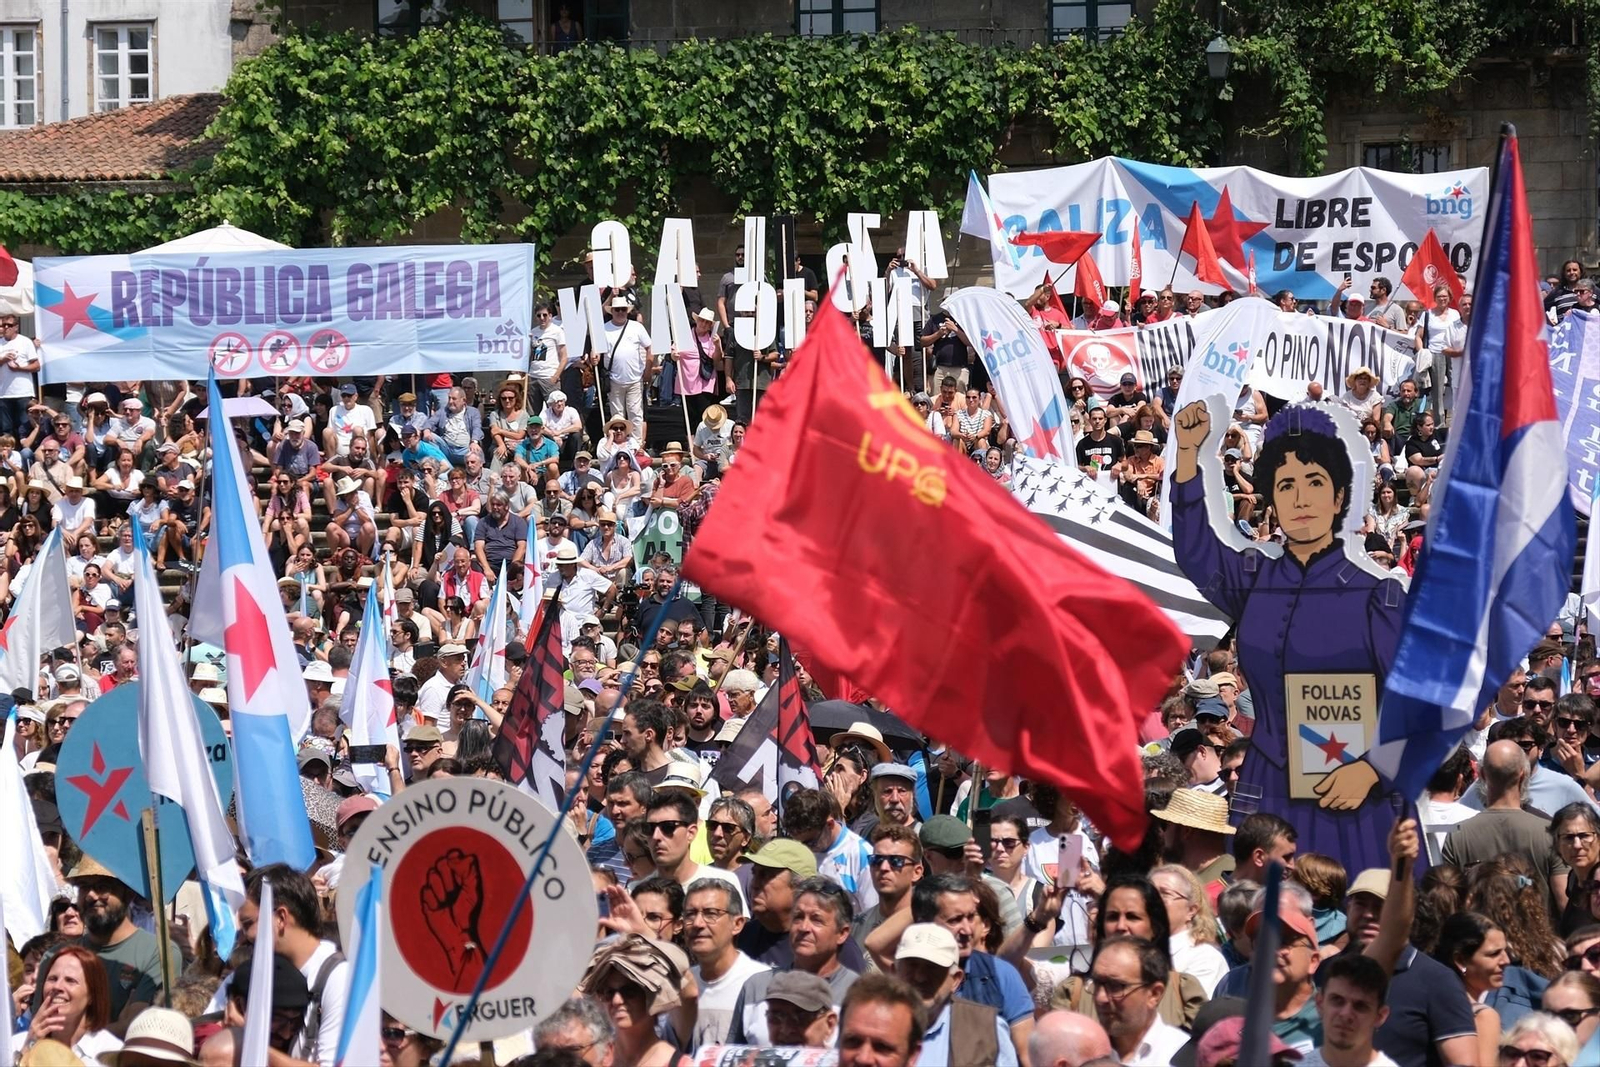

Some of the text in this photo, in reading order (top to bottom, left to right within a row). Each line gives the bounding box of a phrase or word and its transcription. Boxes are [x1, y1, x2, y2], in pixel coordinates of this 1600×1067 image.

[1275, 197, 1372, 229] LIBRE
[1425, 193, 1473, 220] bng
[1272, 241, 1472, 274] DE ESPOO
[111, 256, 502, 329] REPÚBLICA GALEGA
[476, 333, 524, 360] bng
[1281, 333, 1320, 382] PINO
[1324, 322, 1387, 397] NON
[1302, 685, 1362, 701] FOLLAS
[1306, 705, 1362, 721] NOVAS
[367, 788, 565, 900] ENSINO PÚBLICO
